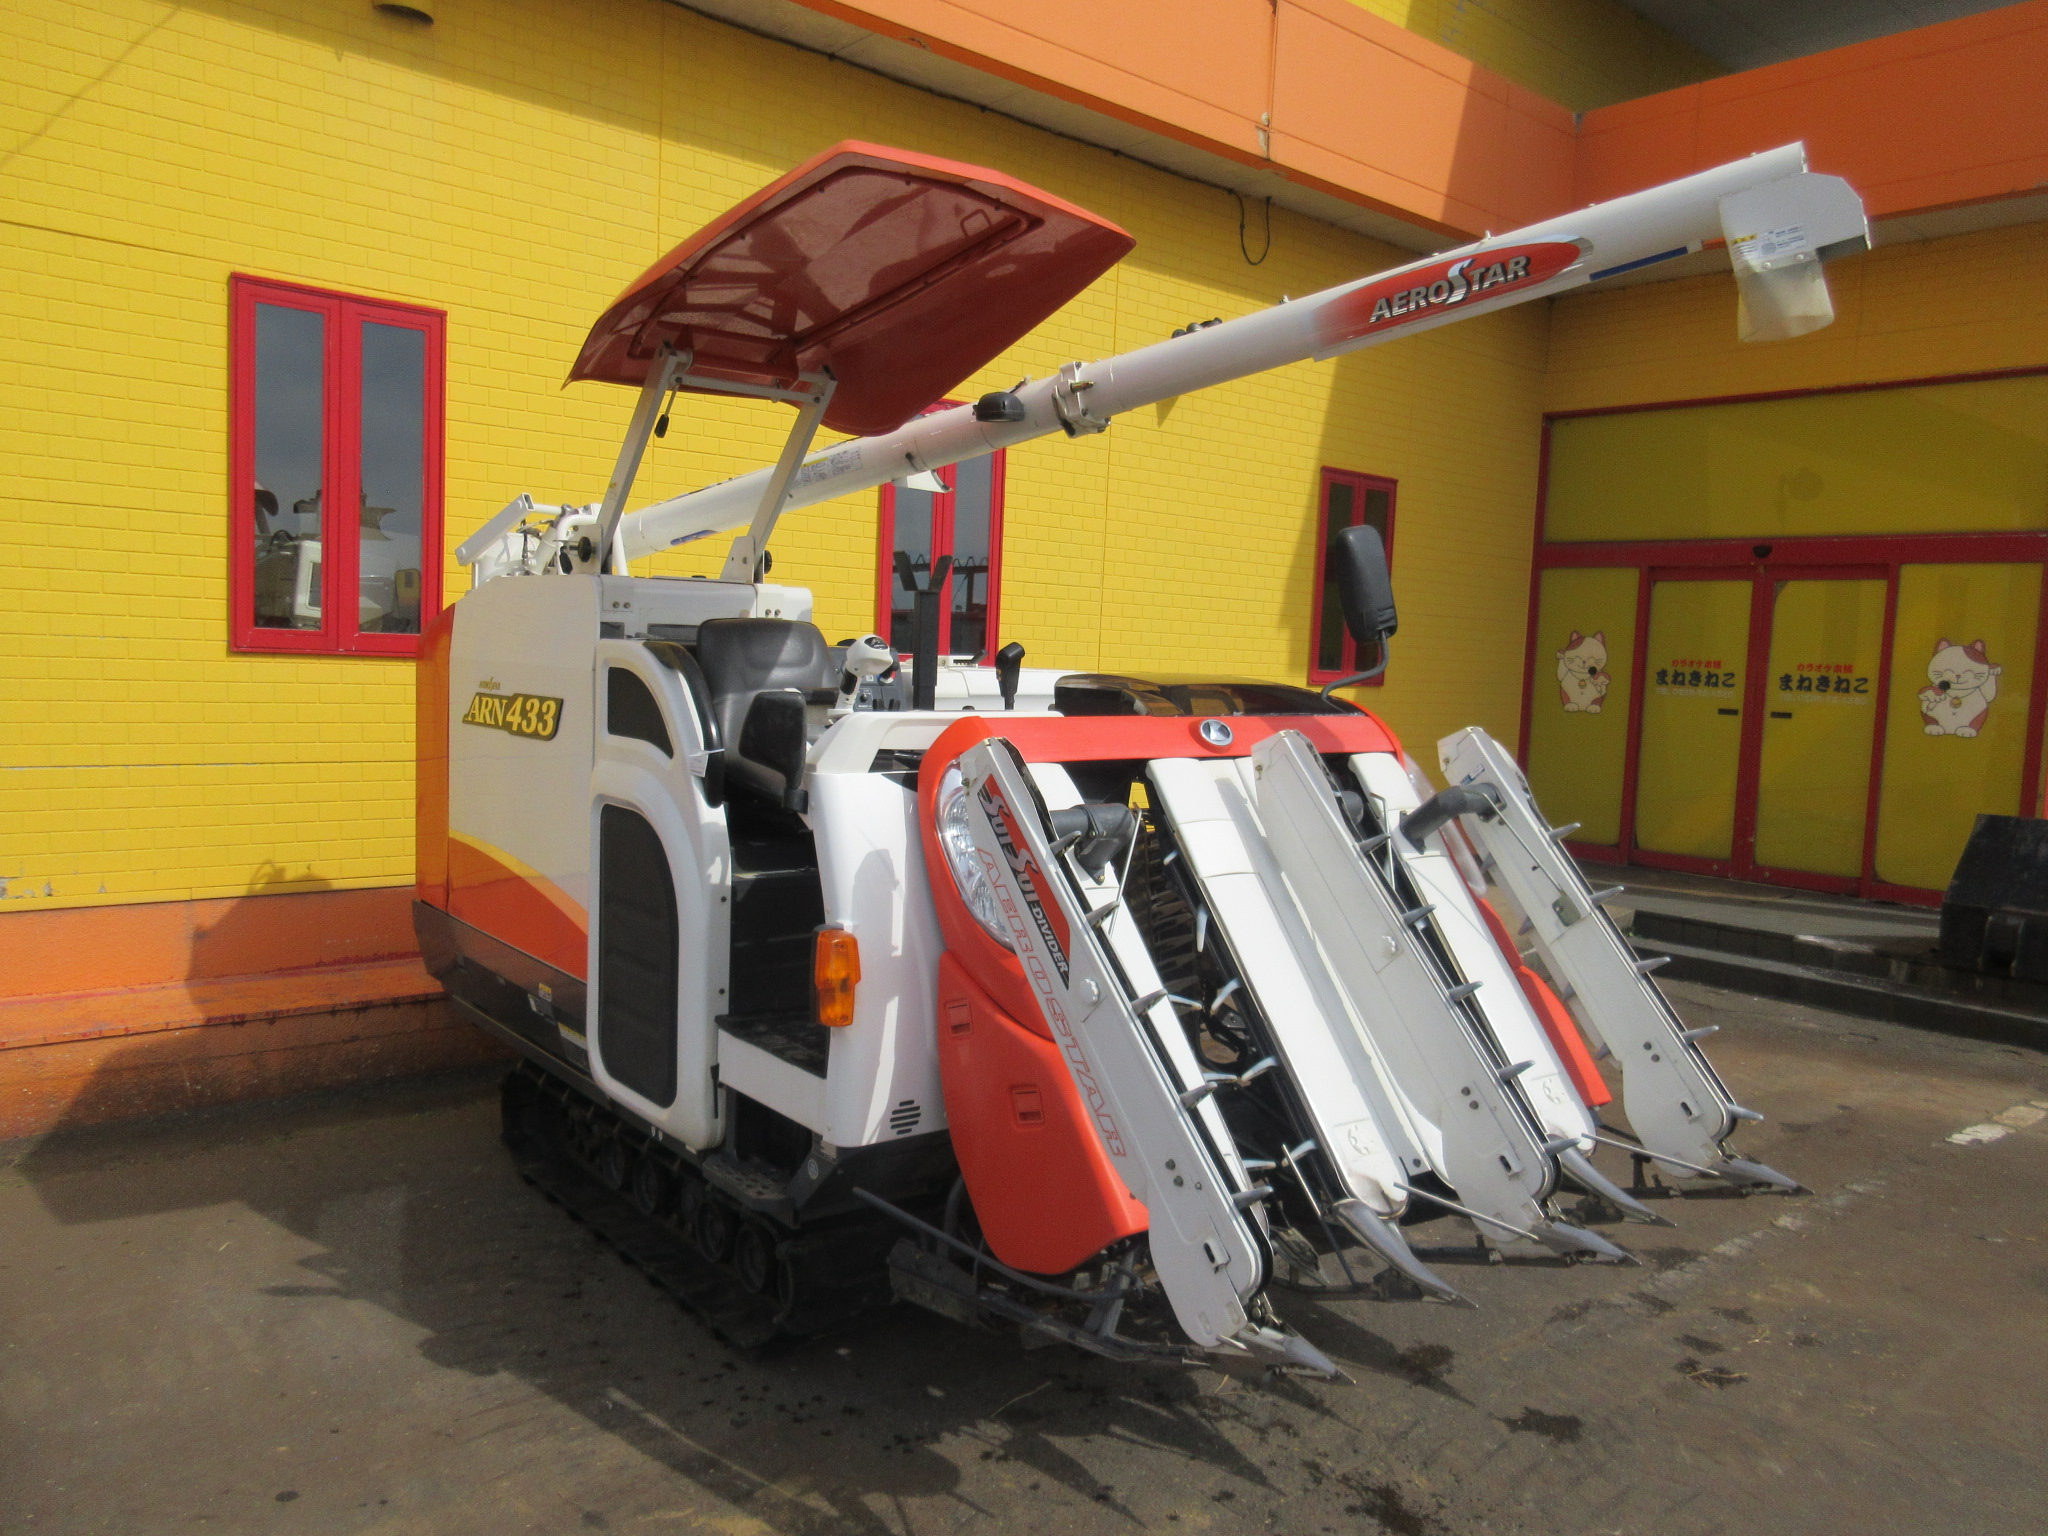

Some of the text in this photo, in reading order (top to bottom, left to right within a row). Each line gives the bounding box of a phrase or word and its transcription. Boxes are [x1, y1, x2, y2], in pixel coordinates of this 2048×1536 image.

[1368, 257, 1531, 324] AEROSTAR
[1656, 668, 1736, 688] まねきねこ
[1779, 673, 1869, 694] まねきねこ
[977, 848, 1127, 1157] AEROSTAR
